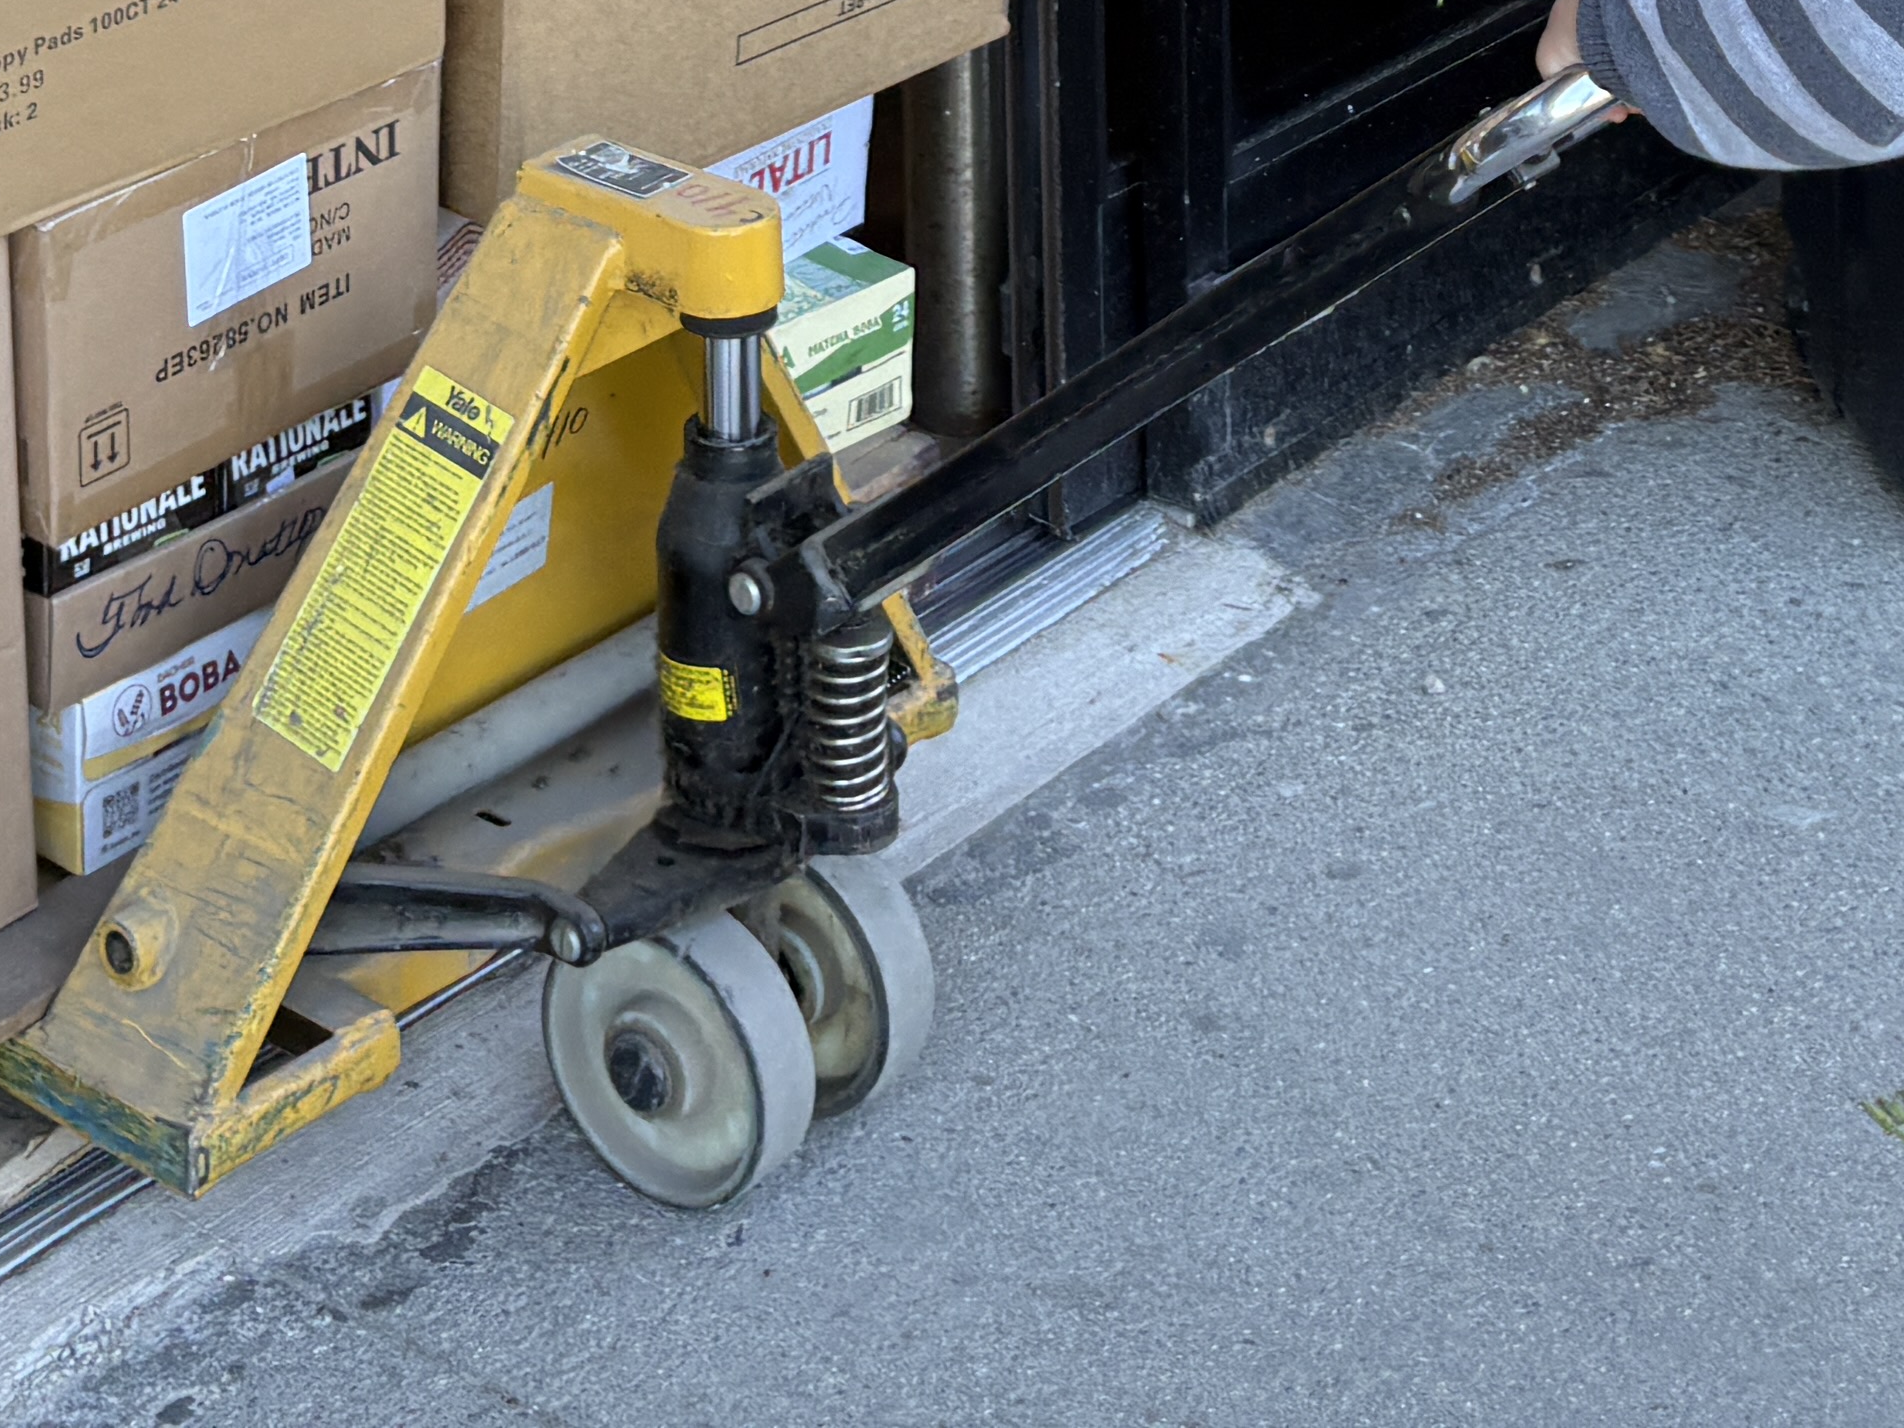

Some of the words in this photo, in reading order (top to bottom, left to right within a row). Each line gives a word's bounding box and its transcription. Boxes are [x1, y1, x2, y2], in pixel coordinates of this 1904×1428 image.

[34, 24, 84, 57] Pads
[25, 102, 39, 121] 2
[306, 119, 401, 196] INTE
[309, 202, 350, 234] C/NO
[311, 225, 351, 256] MAD
[299, 273, 350, 315] ITEM
[807, 330, 851, 358] MATCHA
[444, 384, 482, 421] Yale
[430, 418, 492, 466] WARNING
[102, 516, 167, 557] BREWING
[158, 649, 244, 717] BOBA
